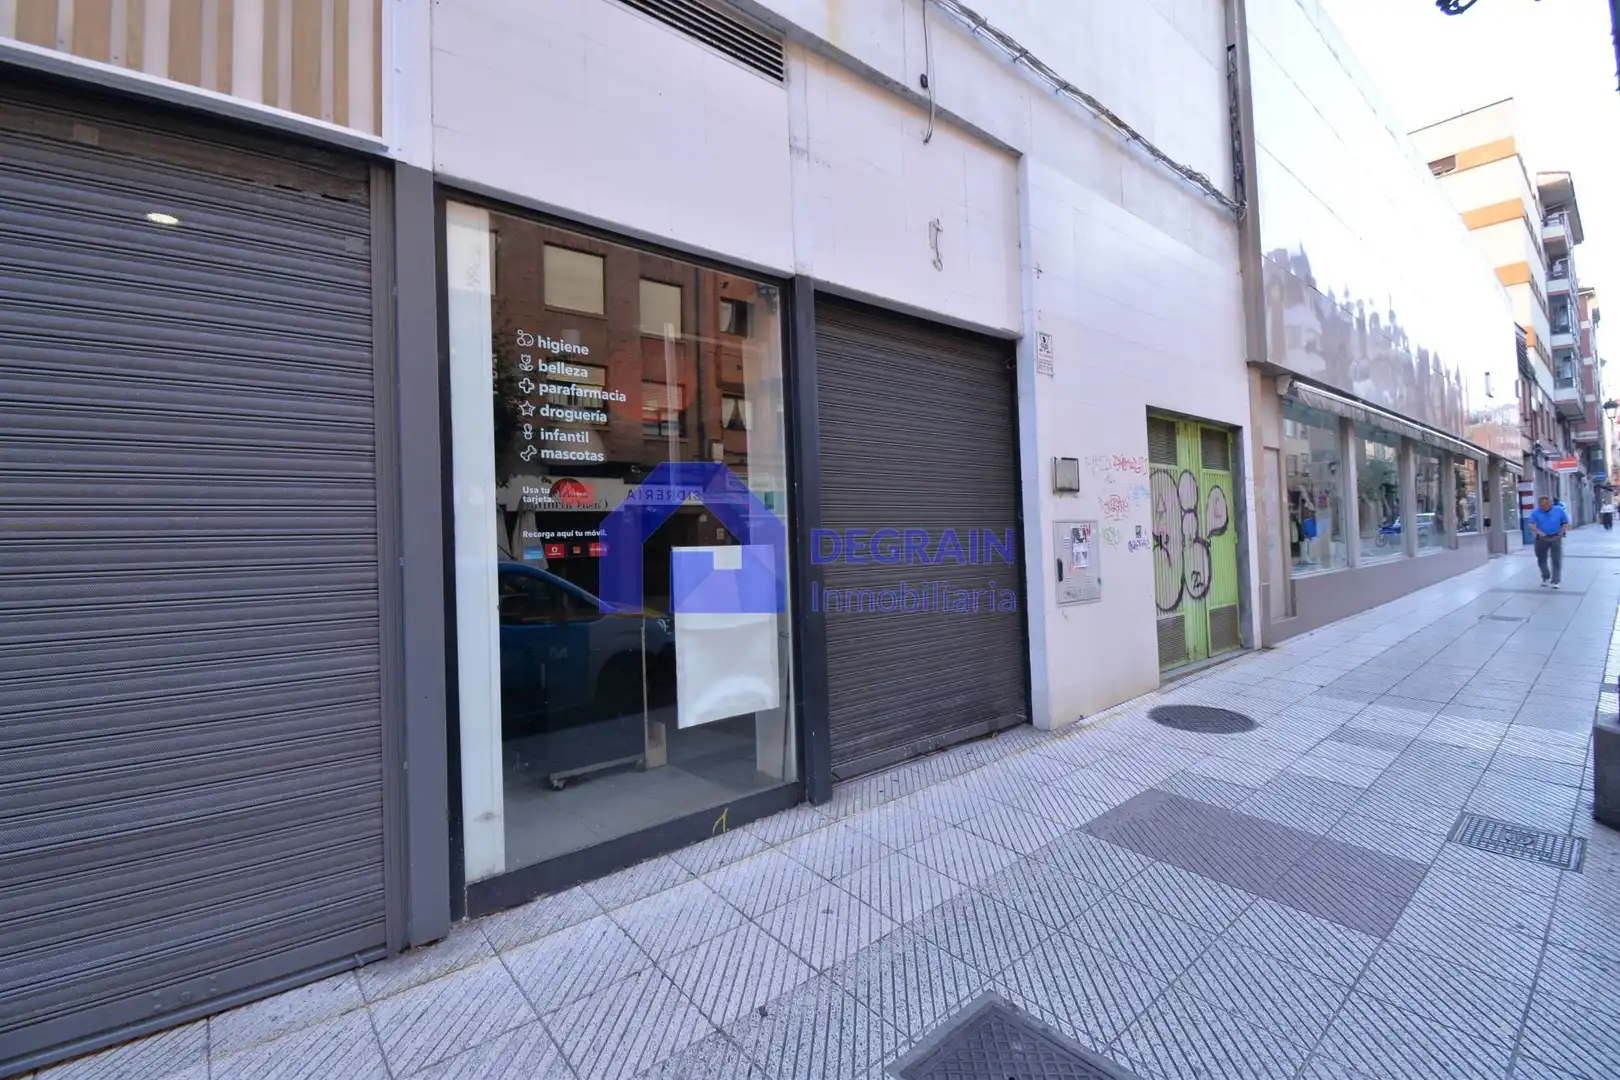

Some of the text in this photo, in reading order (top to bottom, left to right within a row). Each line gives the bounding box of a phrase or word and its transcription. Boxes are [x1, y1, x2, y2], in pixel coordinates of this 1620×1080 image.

[537, 335, 589, 355] higiene
[538, 359, 588, 378] belleza
[539, 383, 627, 402] parafarmacia
[540, 403, 608, 423] droguería
[540, 428, 590, 443] infantil
[540, 448, 605, 462] mascotas
[522, 486, 539, 494] Usa
[522, 495, 555, 505] tarjeta.
[522, 530, 555, 539] Recarga
[556, 529, 574, 539] aquí
